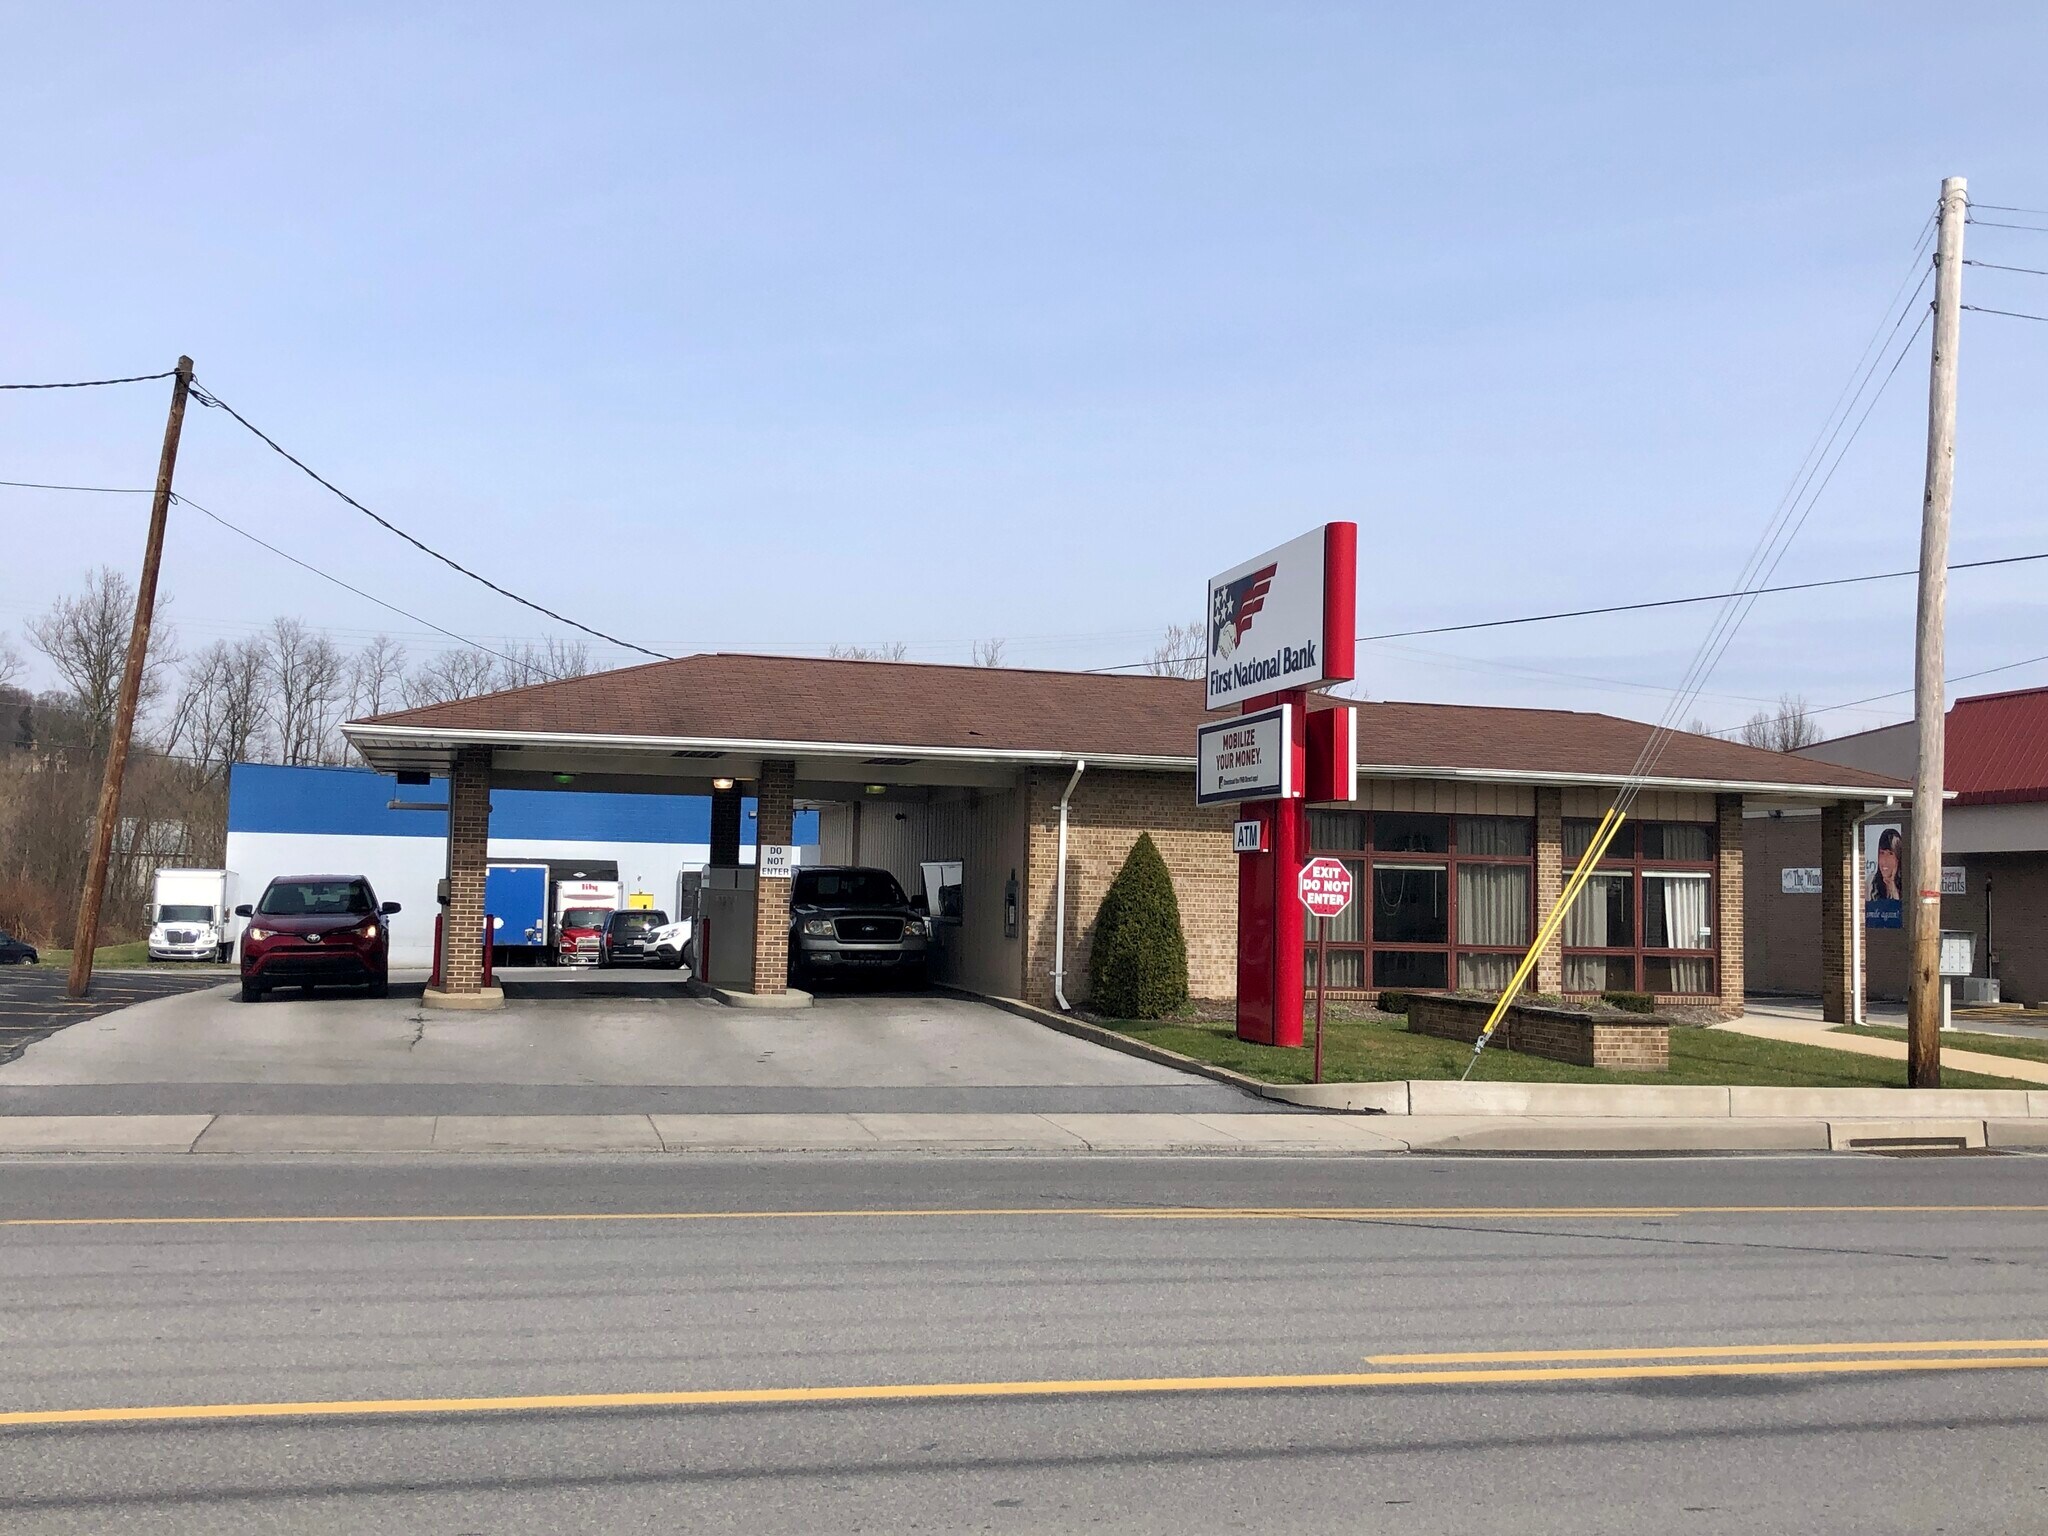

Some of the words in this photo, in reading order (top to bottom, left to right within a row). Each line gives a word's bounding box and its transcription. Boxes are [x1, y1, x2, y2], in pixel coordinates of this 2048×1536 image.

[1210, 667, 1232, 696] First
[1234, 650, 1280, 689] National
[1283, 639, 1316, 674] Bank
[1222, 728, 1255, 751] MOBILIZE
[1216, 752, 1234, 771] YOUR
[1235, 747, 1262, 768] MONEY.
[1237, 825, 1258, 847] ATM
[770, 846, 782, 854] DO
[767, 857, 784, 865] NOT
[762, 867, 789, 875] ENTER
[1312, 866, 1341, 878] EXIT
[1303, 879, 1321, 891] DO
[1323, 880, 1350, 892] NOT
[1307, 892, 1344, 905] ENTER
